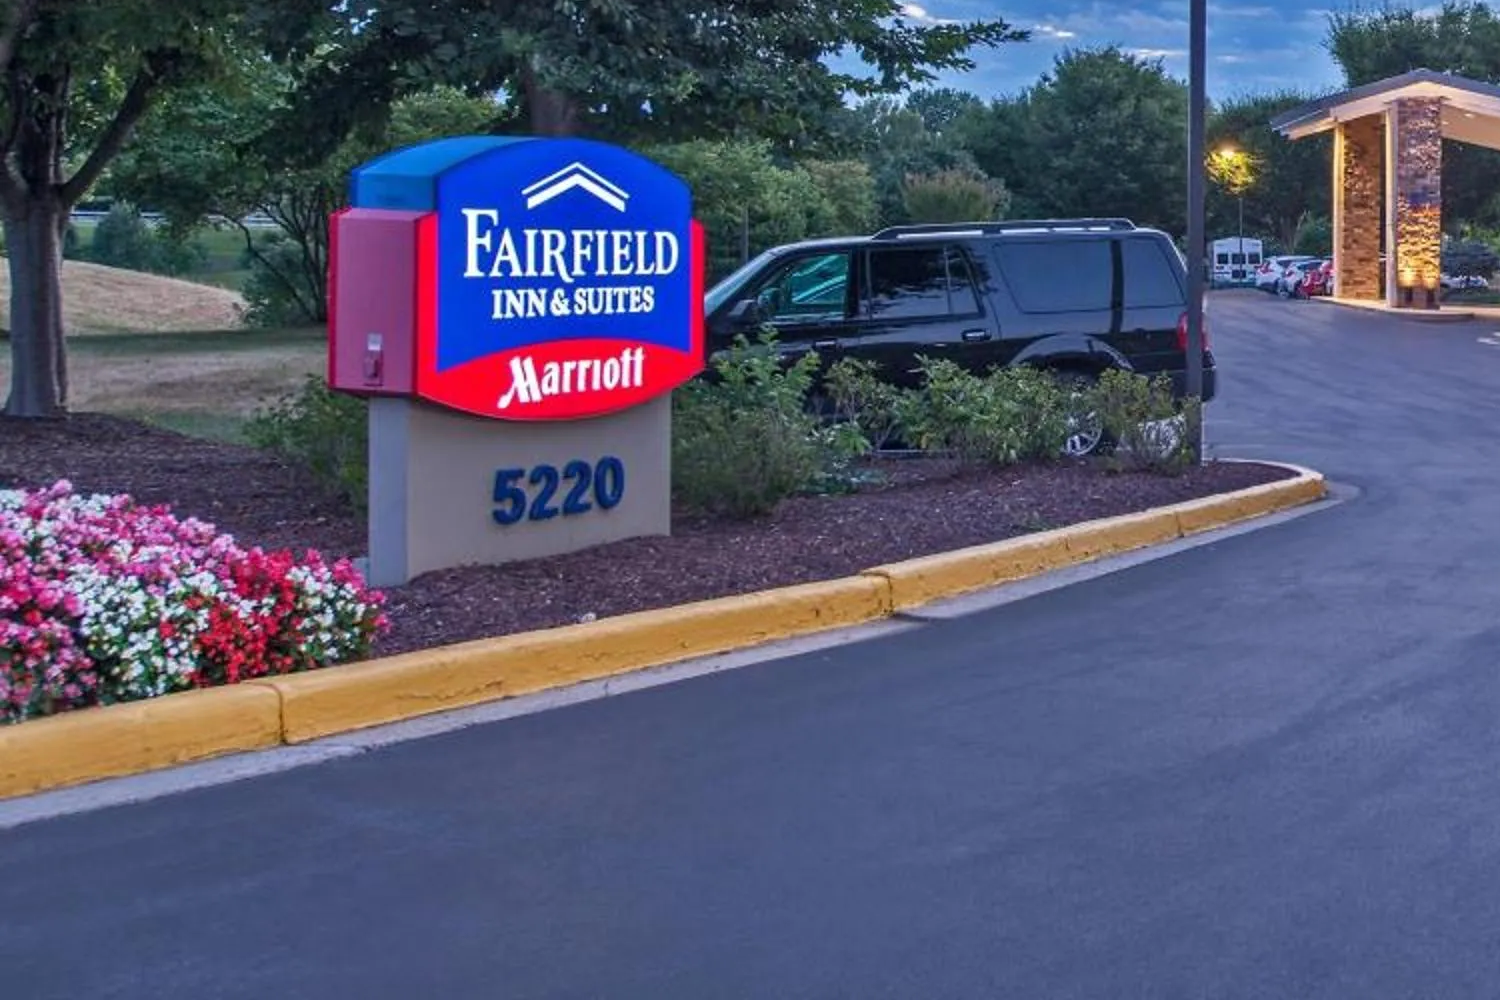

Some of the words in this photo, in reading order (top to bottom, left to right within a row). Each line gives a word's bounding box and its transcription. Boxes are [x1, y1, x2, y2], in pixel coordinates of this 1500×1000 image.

[462, 208, 679, 283] FAIRFIELD
[491, 288, 548, 320] INN
[573, 285, 655, 315] SUITES
[497, 346, 645, 409] Marriott
[492, 456, 625, 526] 5220
